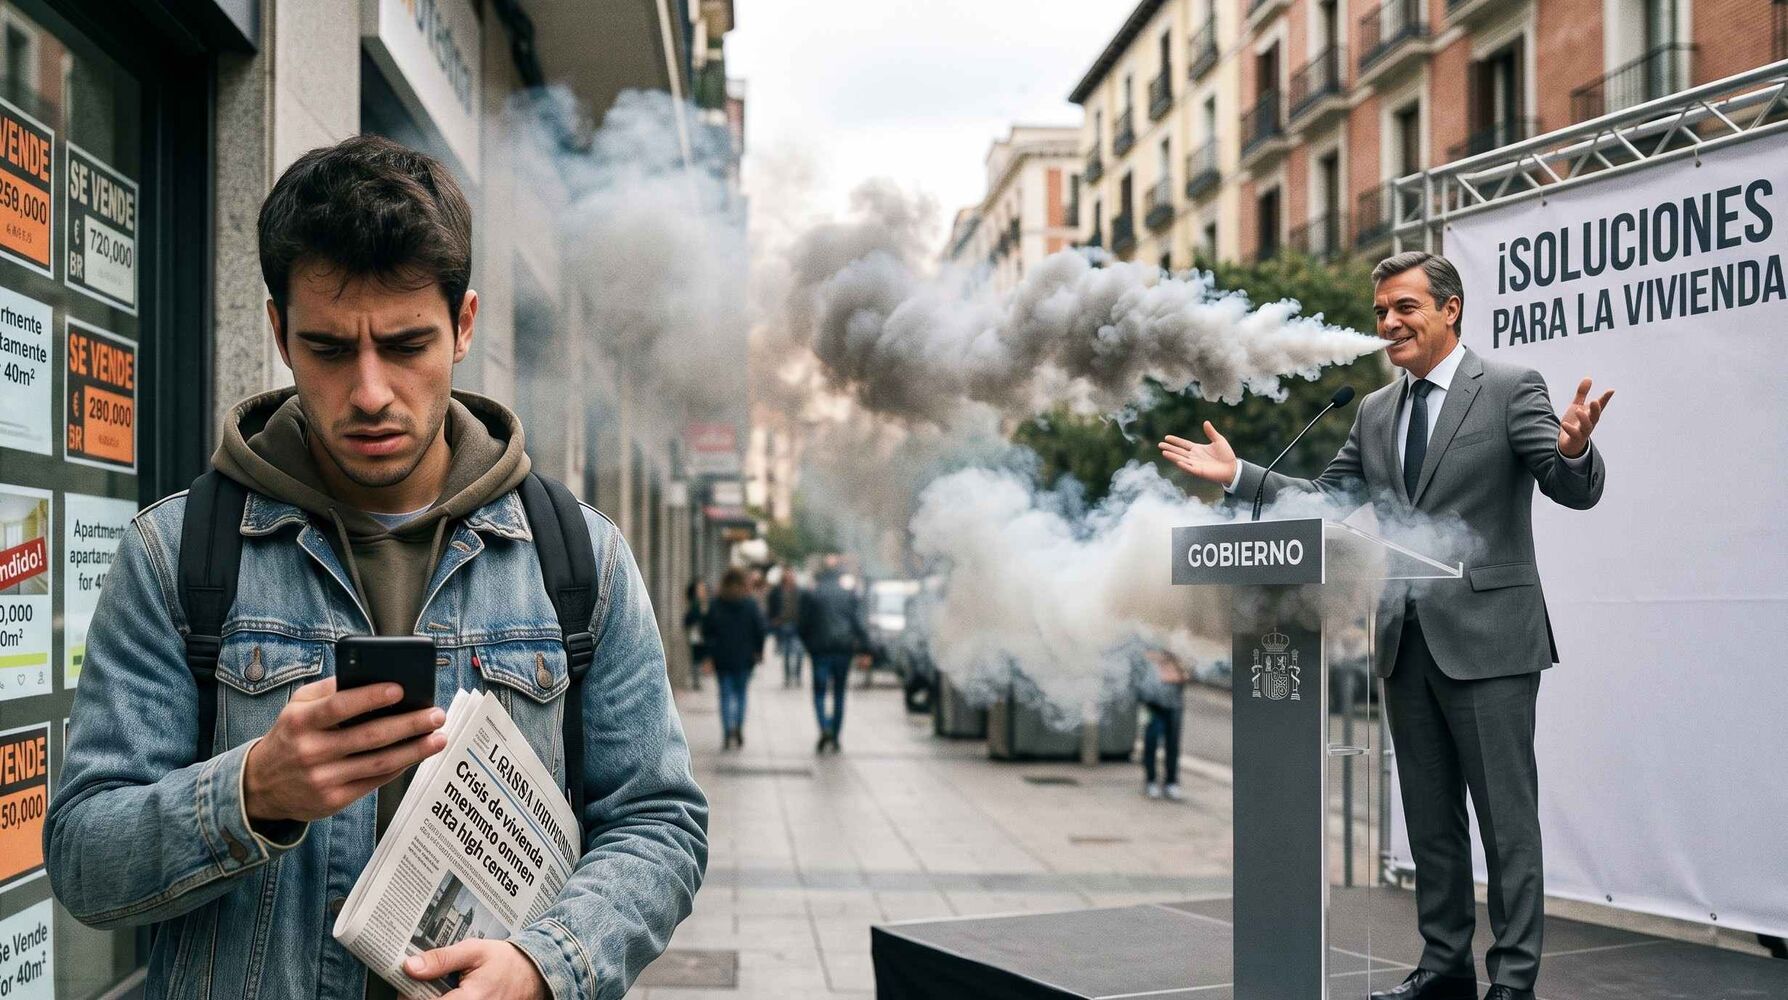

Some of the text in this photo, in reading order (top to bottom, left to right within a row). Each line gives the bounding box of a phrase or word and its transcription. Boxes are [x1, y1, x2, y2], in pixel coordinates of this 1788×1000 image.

[70, 160, 134, 231] SE VENDE
[90, 228, 132, 268] 720,000
[1498, 178, 1773, 295] ¡SOLUCIONES
[70, 250, 84, 279] BR
[1493, 254, 1787, 349] PARA LA VIVIENDA
[69, 333, 133, 390] SE VENDE
[89, 396, 131, 428] 280,000
[68, 423, 83, 451] BR
[1187, 539, 1304, 568] GOBIERNO
[79, 572, 93, 591] for
[431, 801, 459, 832] alta
[456, 760, 489, 803] Crisis
[488, 798, 504, 821] de
[502, 818, 544, 869] vivienda
[13, 921, 48, 956] Vende
